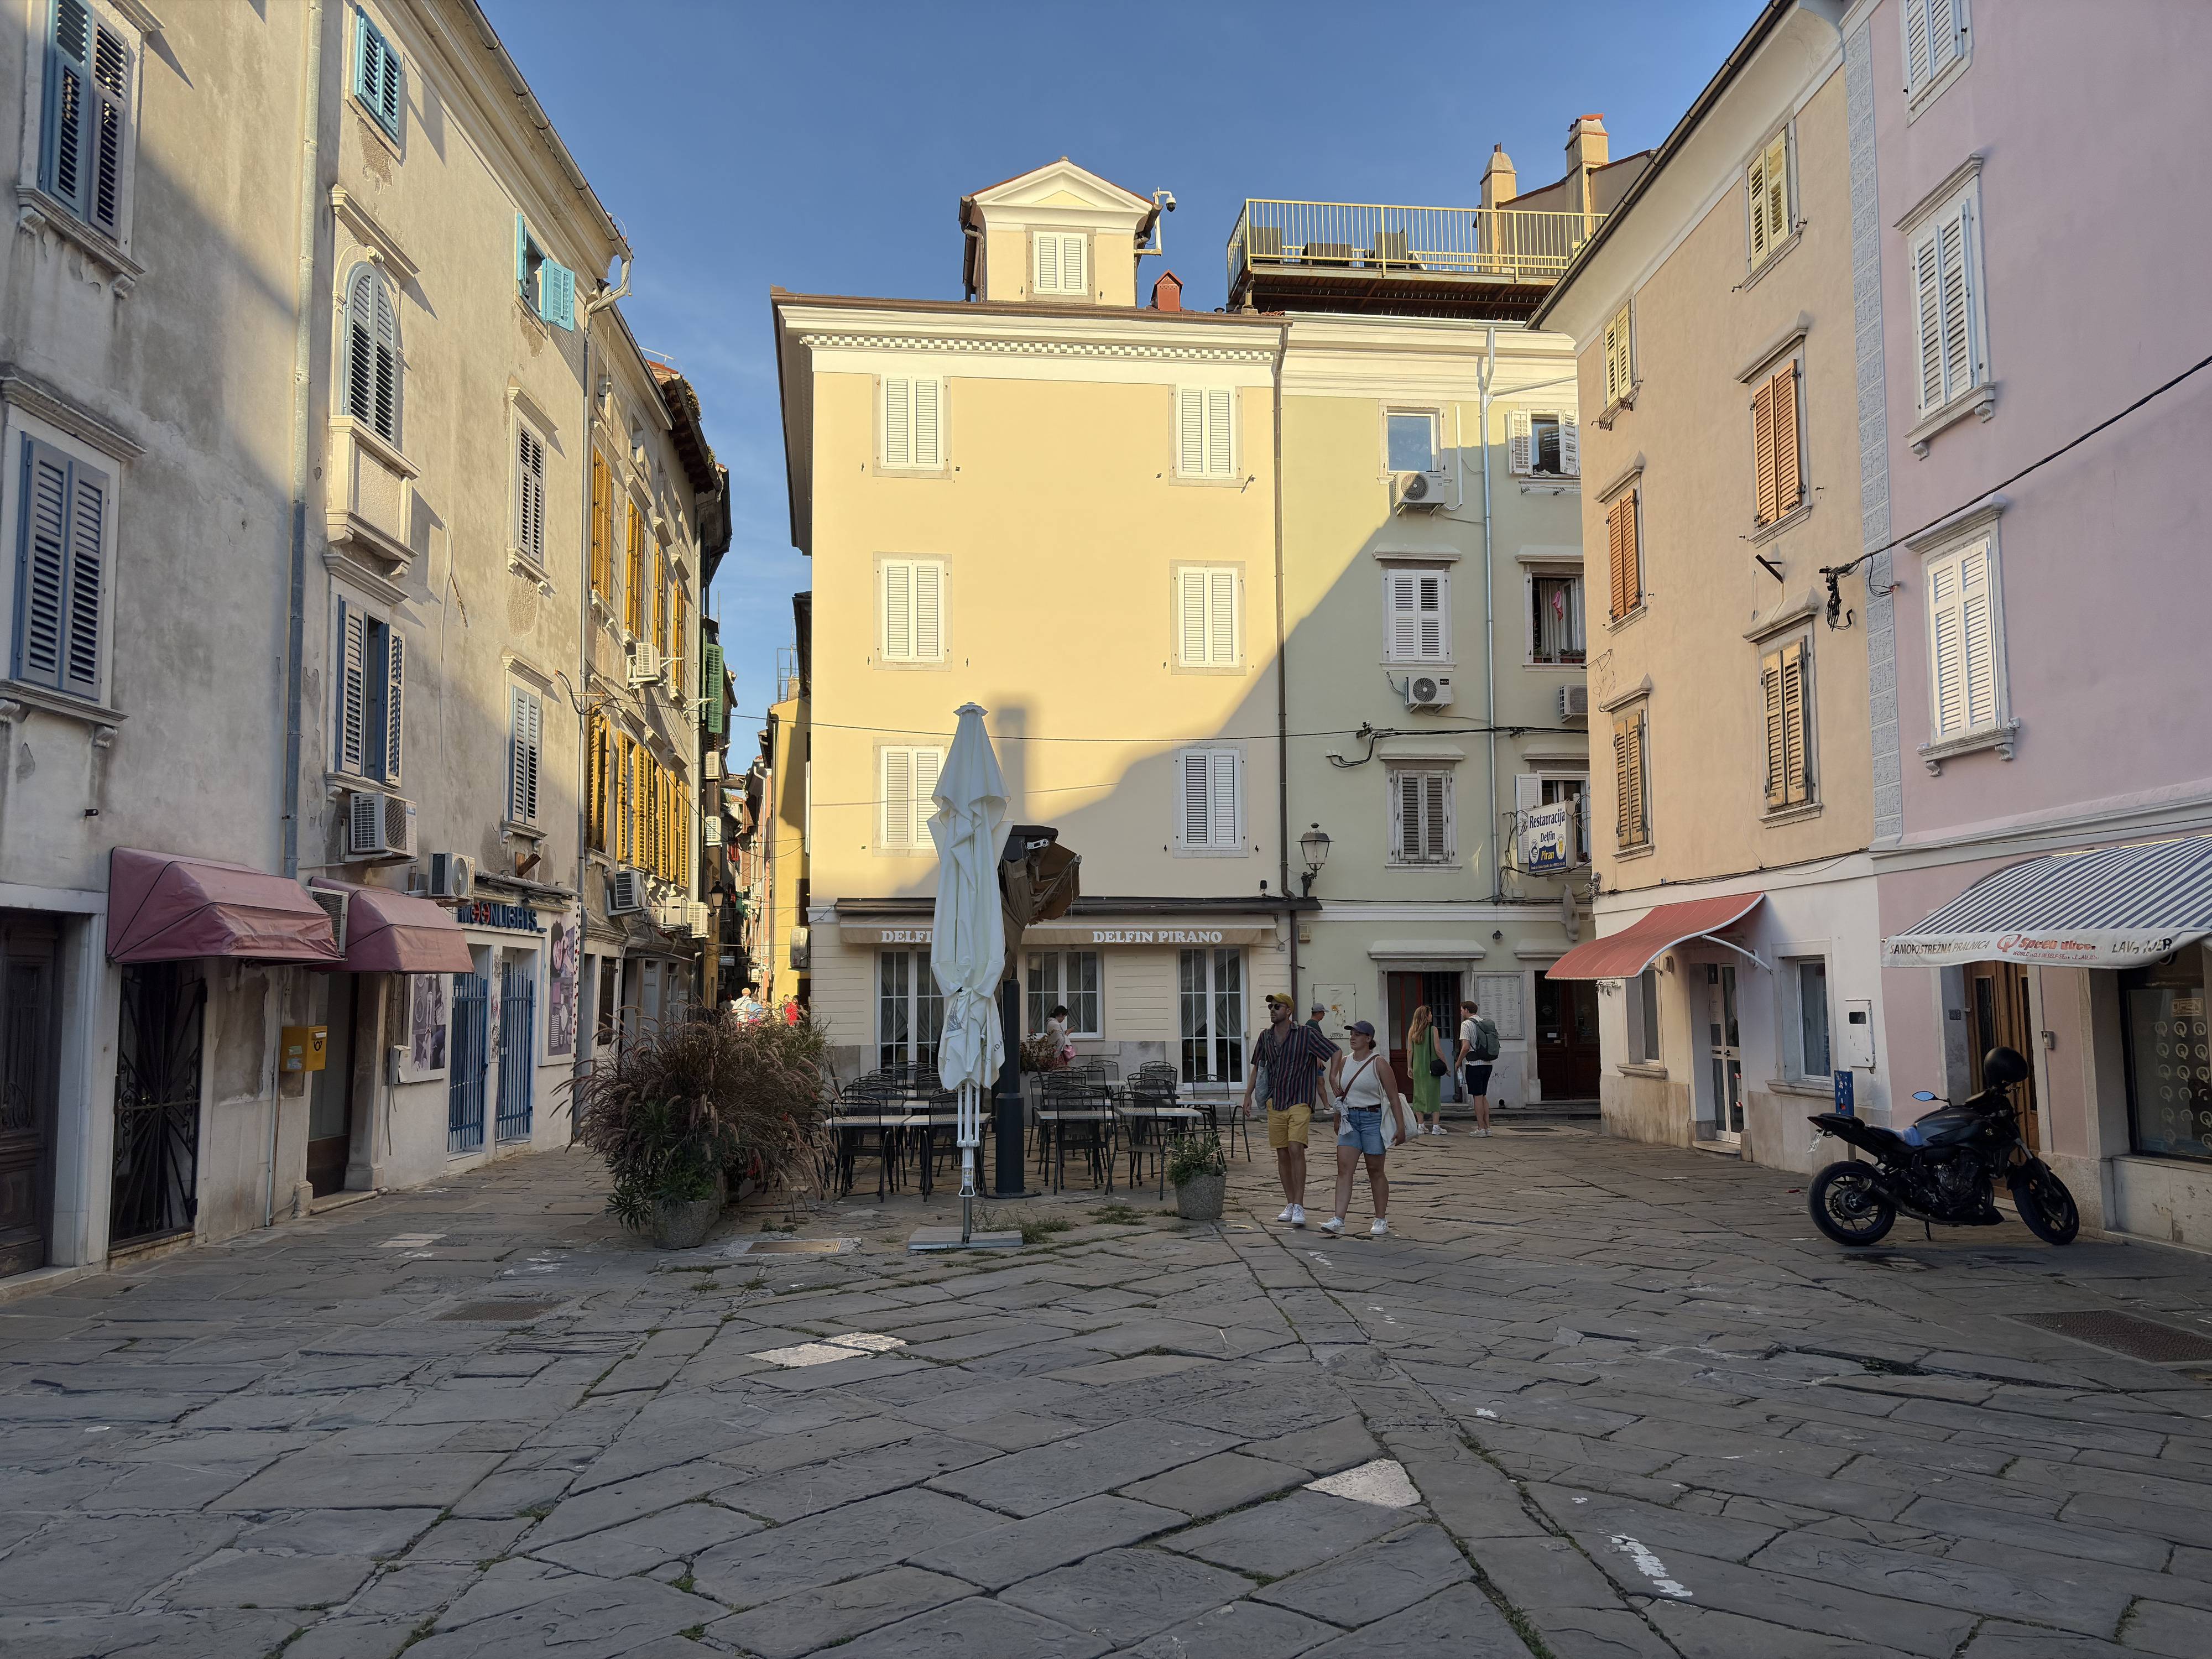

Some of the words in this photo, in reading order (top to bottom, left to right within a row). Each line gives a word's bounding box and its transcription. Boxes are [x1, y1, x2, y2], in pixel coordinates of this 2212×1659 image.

[1540, 831, 1555, 843] Delfin
[1541, 850, 1554, 861] Piran
[881, 930, 932, 943] DELFI
[1092, 931, 1154, 943] DELFIN
[1157, 931, 1223, 943] PIRANO
[1890, 941, 1951, 954] SAMOPOSTREŽNA
[1952, 940, 1991, 953] PRALNICA
